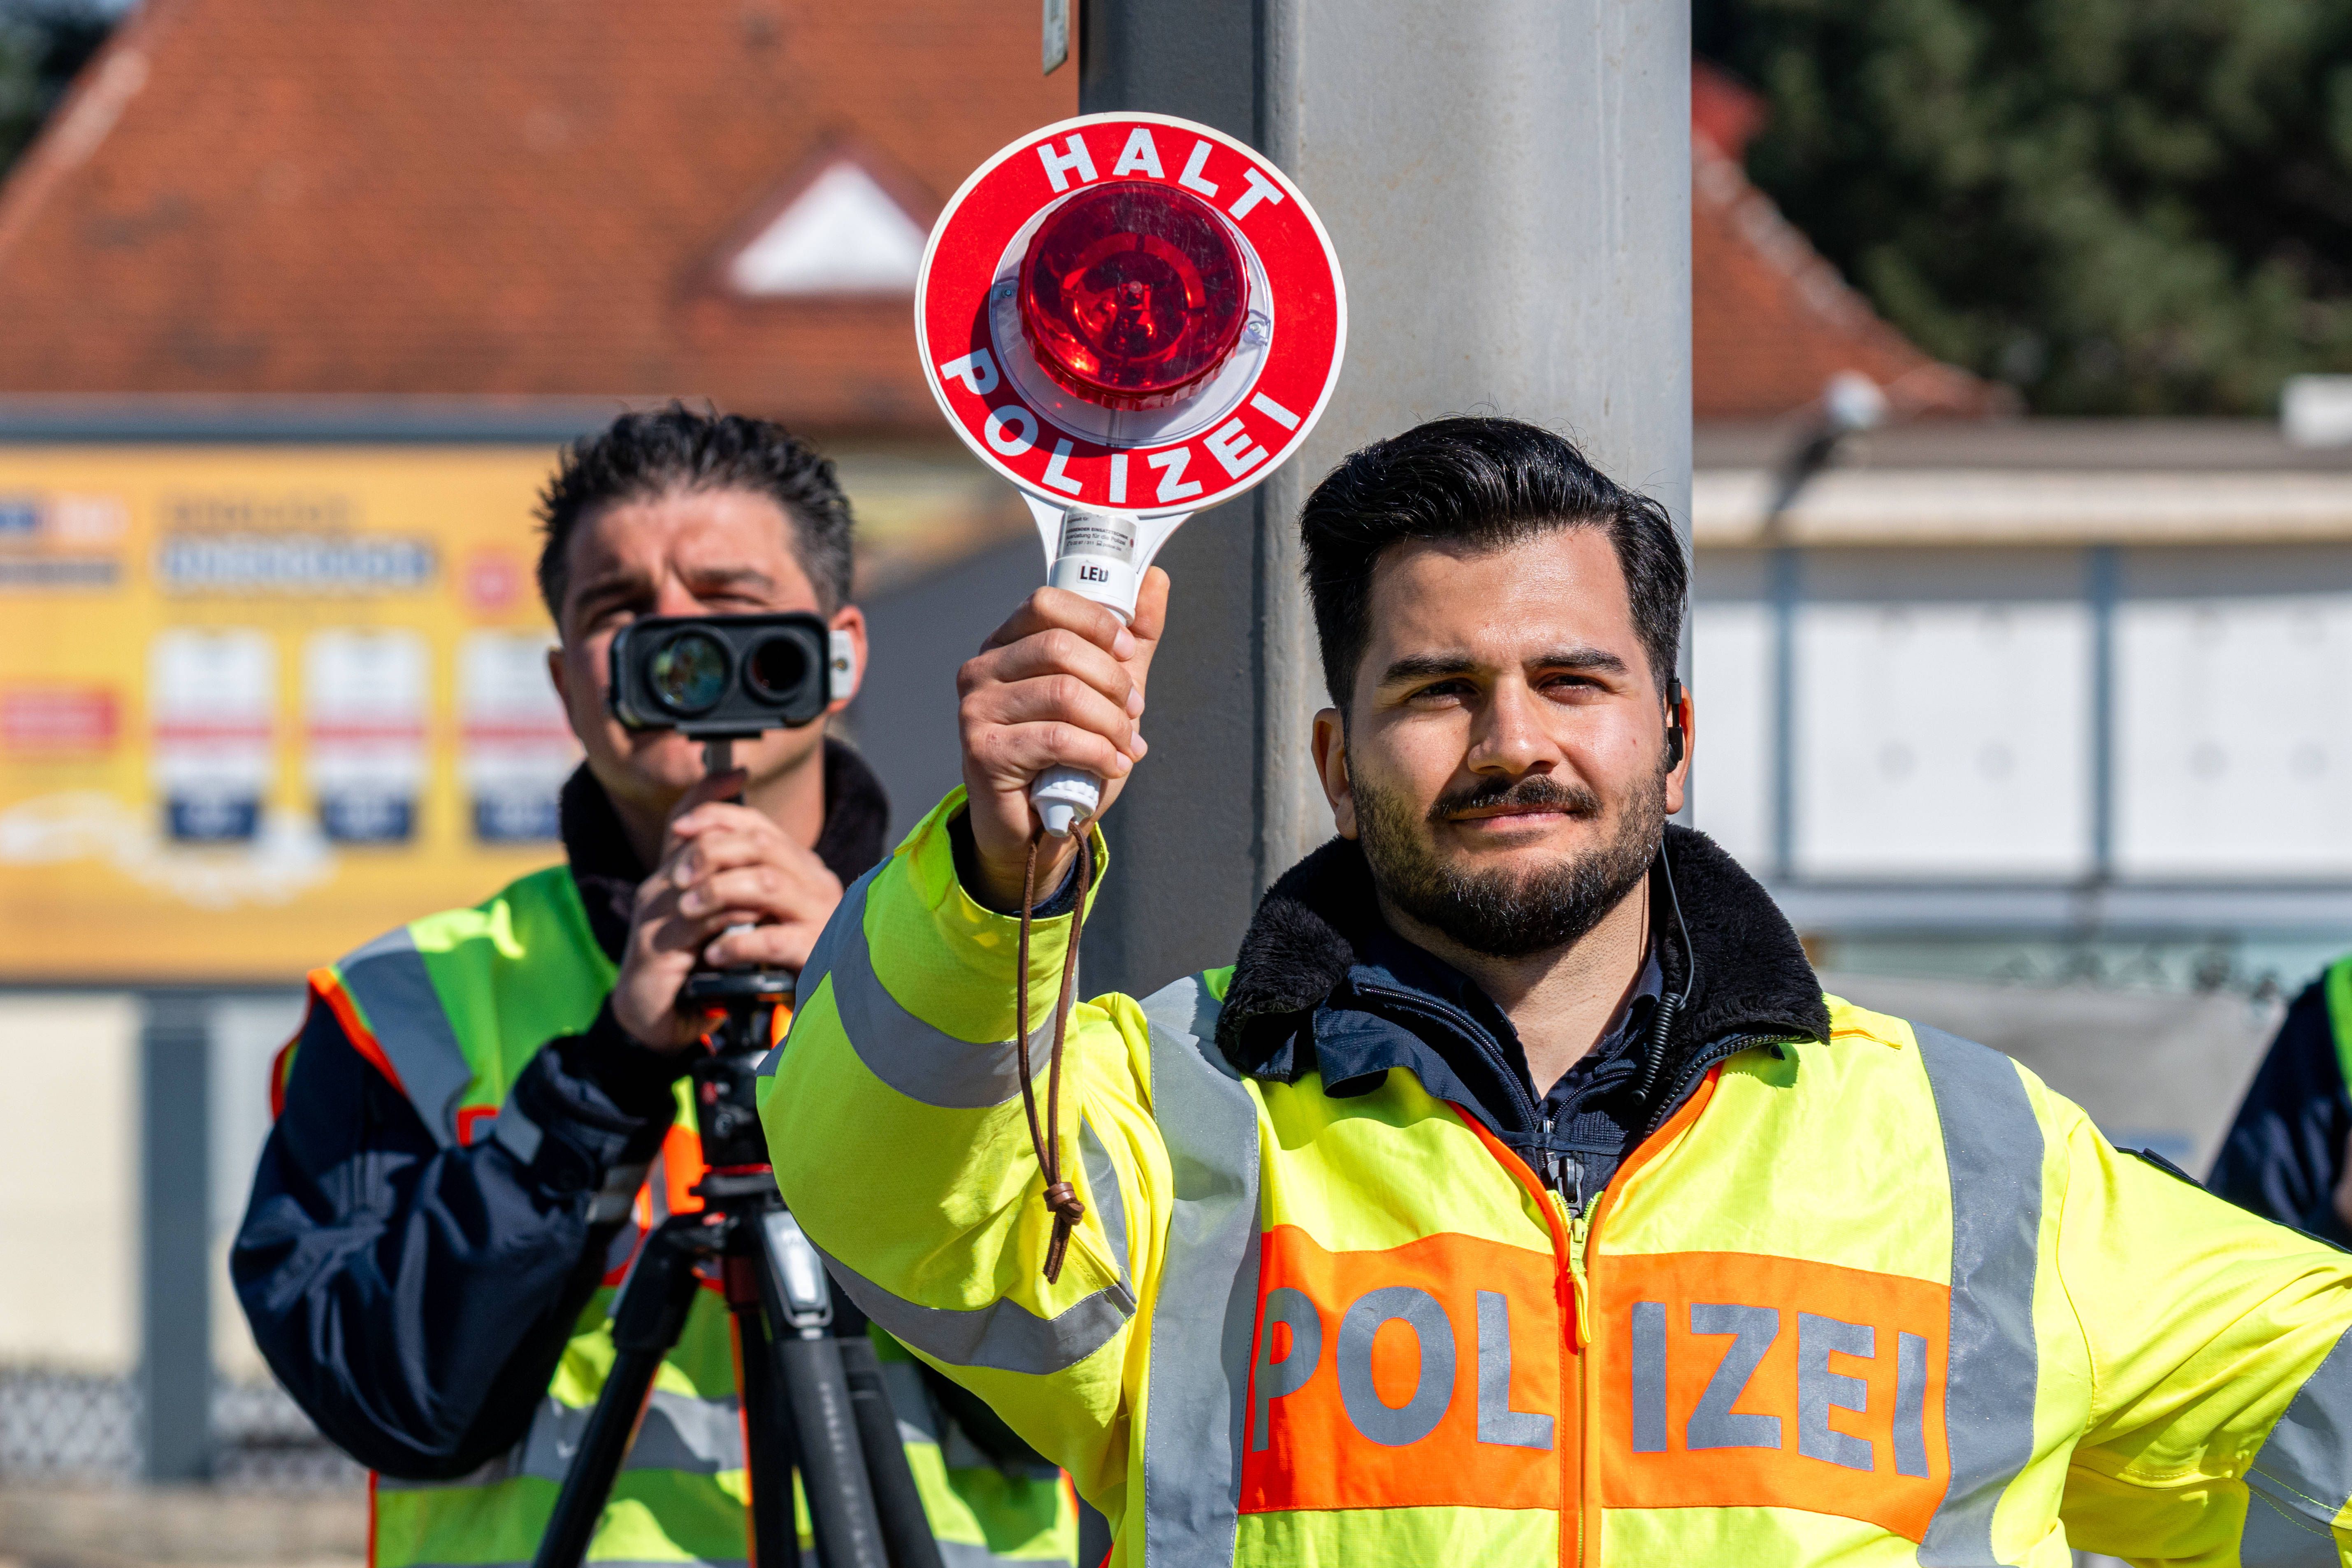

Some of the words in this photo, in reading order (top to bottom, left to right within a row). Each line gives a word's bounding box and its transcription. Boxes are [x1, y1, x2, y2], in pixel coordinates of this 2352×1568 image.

[1037, 128, 1284, 221] HALT
[940, 348, 1301, 504] POLIZEI
[1111, 536, 1126, 545] Polizei
[1080, 565, 1109, 583] LED
